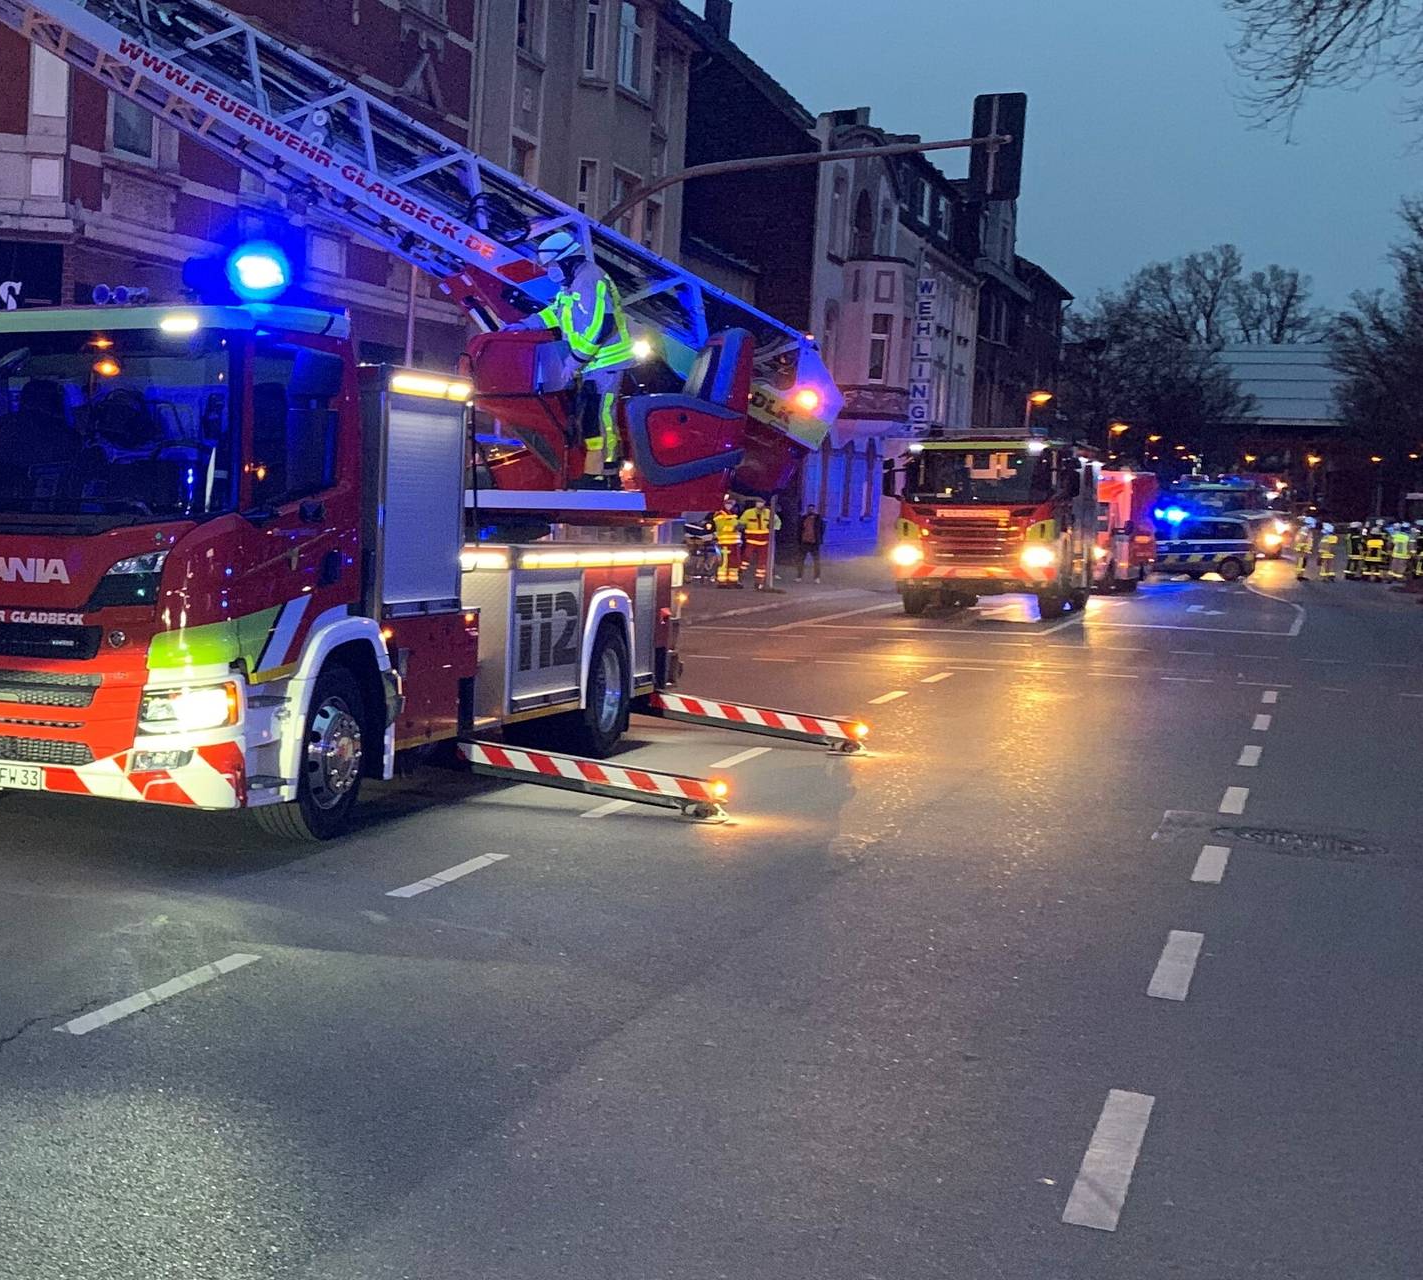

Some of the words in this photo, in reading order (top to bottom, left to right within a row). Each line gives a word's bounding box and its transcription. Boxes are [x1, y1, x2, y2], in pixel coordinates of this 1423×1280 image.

[118, 37, 498, 260] WWW.FEUERWEHR-GLADBECK.DE
[910, 280, 936, 419] WEHLING
[10, 610, 84, 626] GLADBECK
[515, 591, 577, 672] 112
[21, 769, 39, 786] 33
